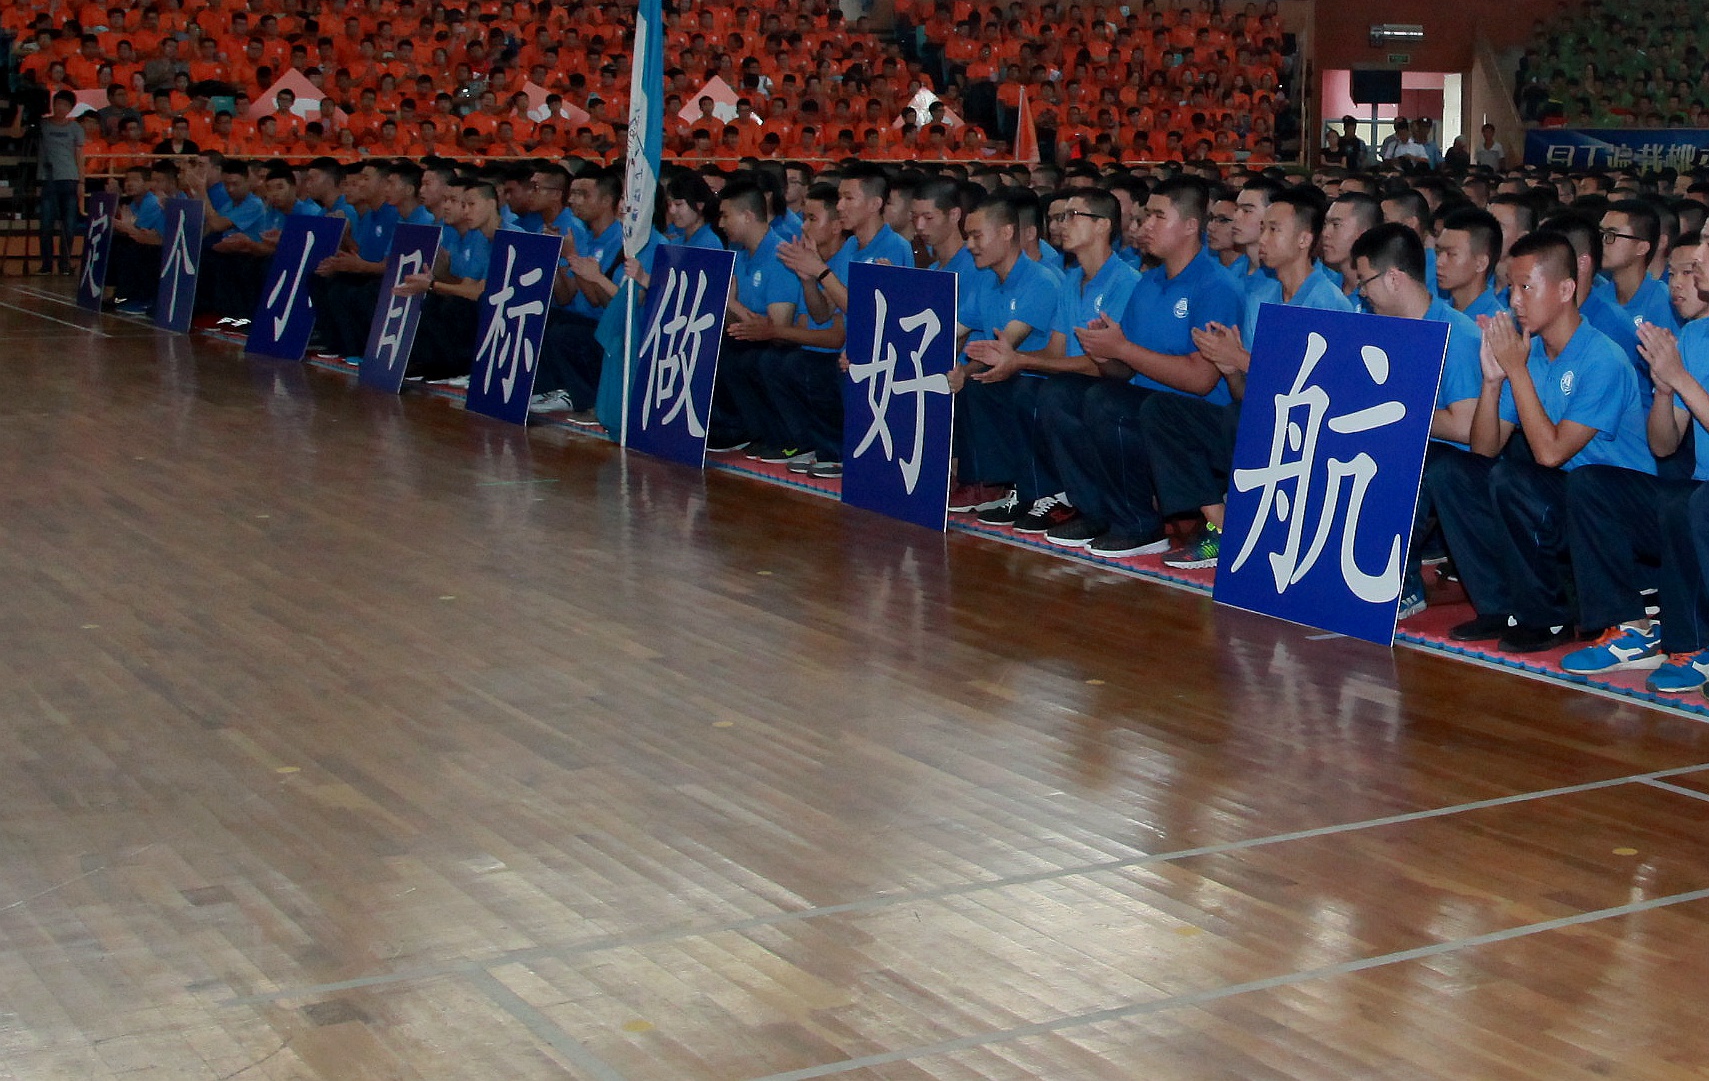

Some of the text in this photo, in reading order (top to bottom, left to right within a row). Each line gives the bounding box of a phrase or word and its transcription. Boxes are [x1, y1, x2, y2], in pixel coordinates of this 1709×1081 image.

[81, 201, 111, 300] 定
[160, 208, 196, 324] 个
[266, 230, 315, 341] 小
[375, 249, 423, 371] 目
[475, 244, 545, 405] 标
[638, 266, 716, 438] 做
[848, 288, 951, 496] 好
[1229, 331, 1407, 606] 航
